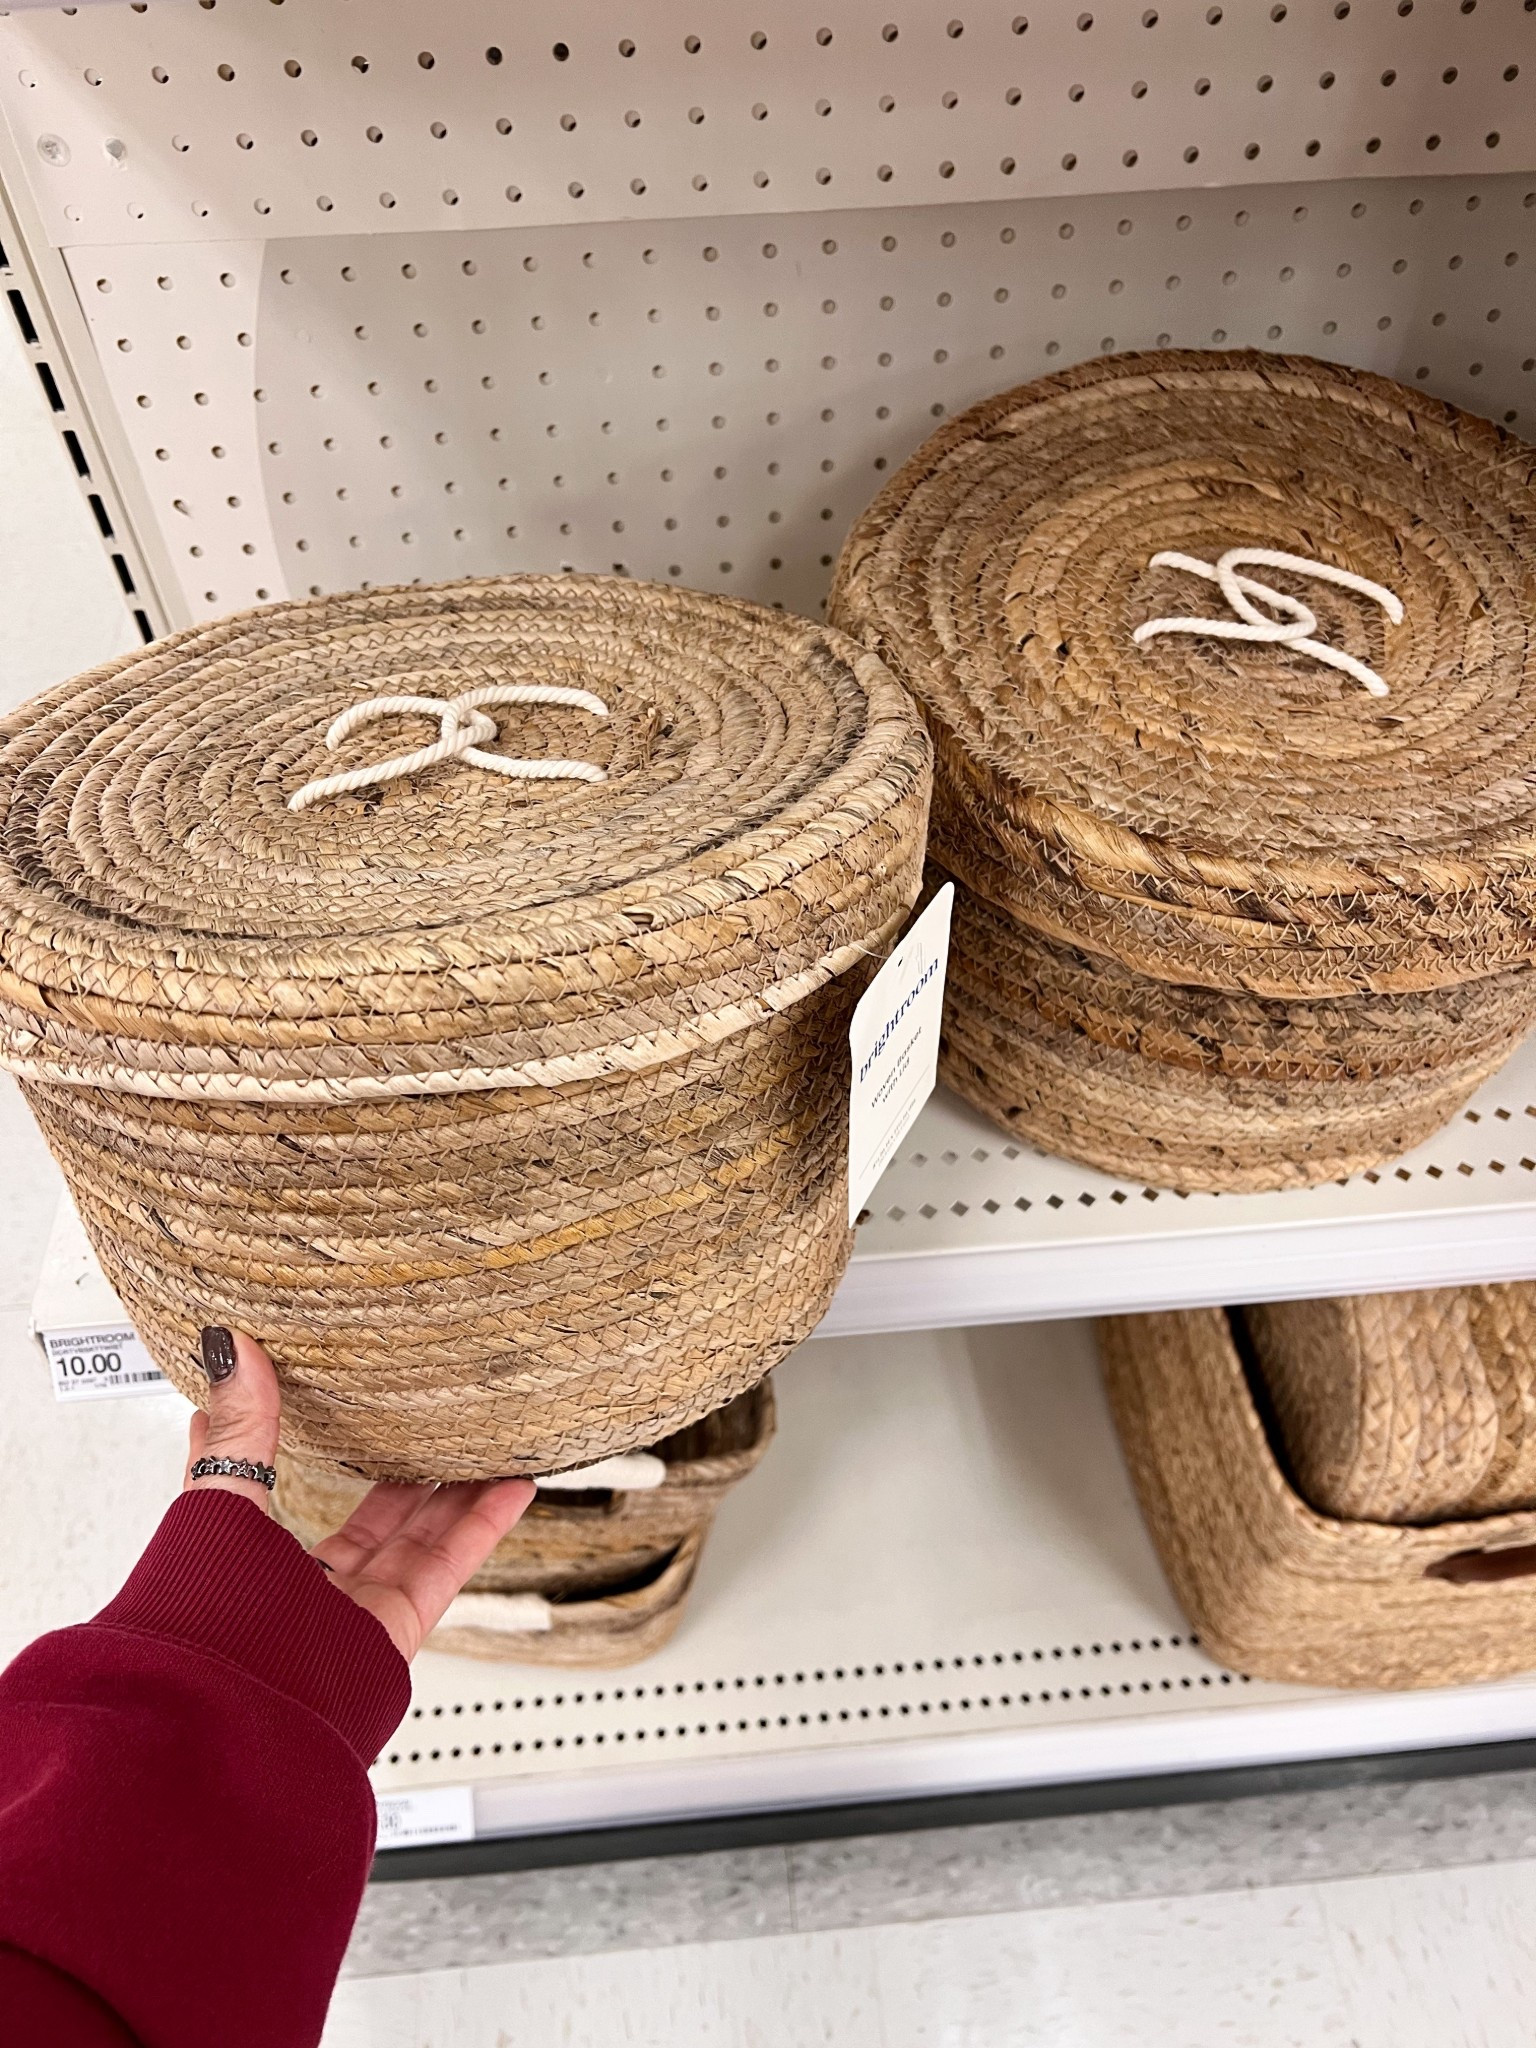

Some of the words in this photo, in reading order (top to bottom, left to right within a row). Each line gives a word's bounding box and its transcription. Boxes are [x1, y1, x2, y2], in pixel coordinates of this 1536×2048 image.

[860, 958, 938, 1083] brightroom
[871, 1066, 896, 1108] Woven
[897, 1026, 922, 1067] Basket
[882, 1077, 898, 1103] with
[50, 1332, 135, 1348] BRIGHTROOM
[57, 1352, 121, 1376] 10.00
